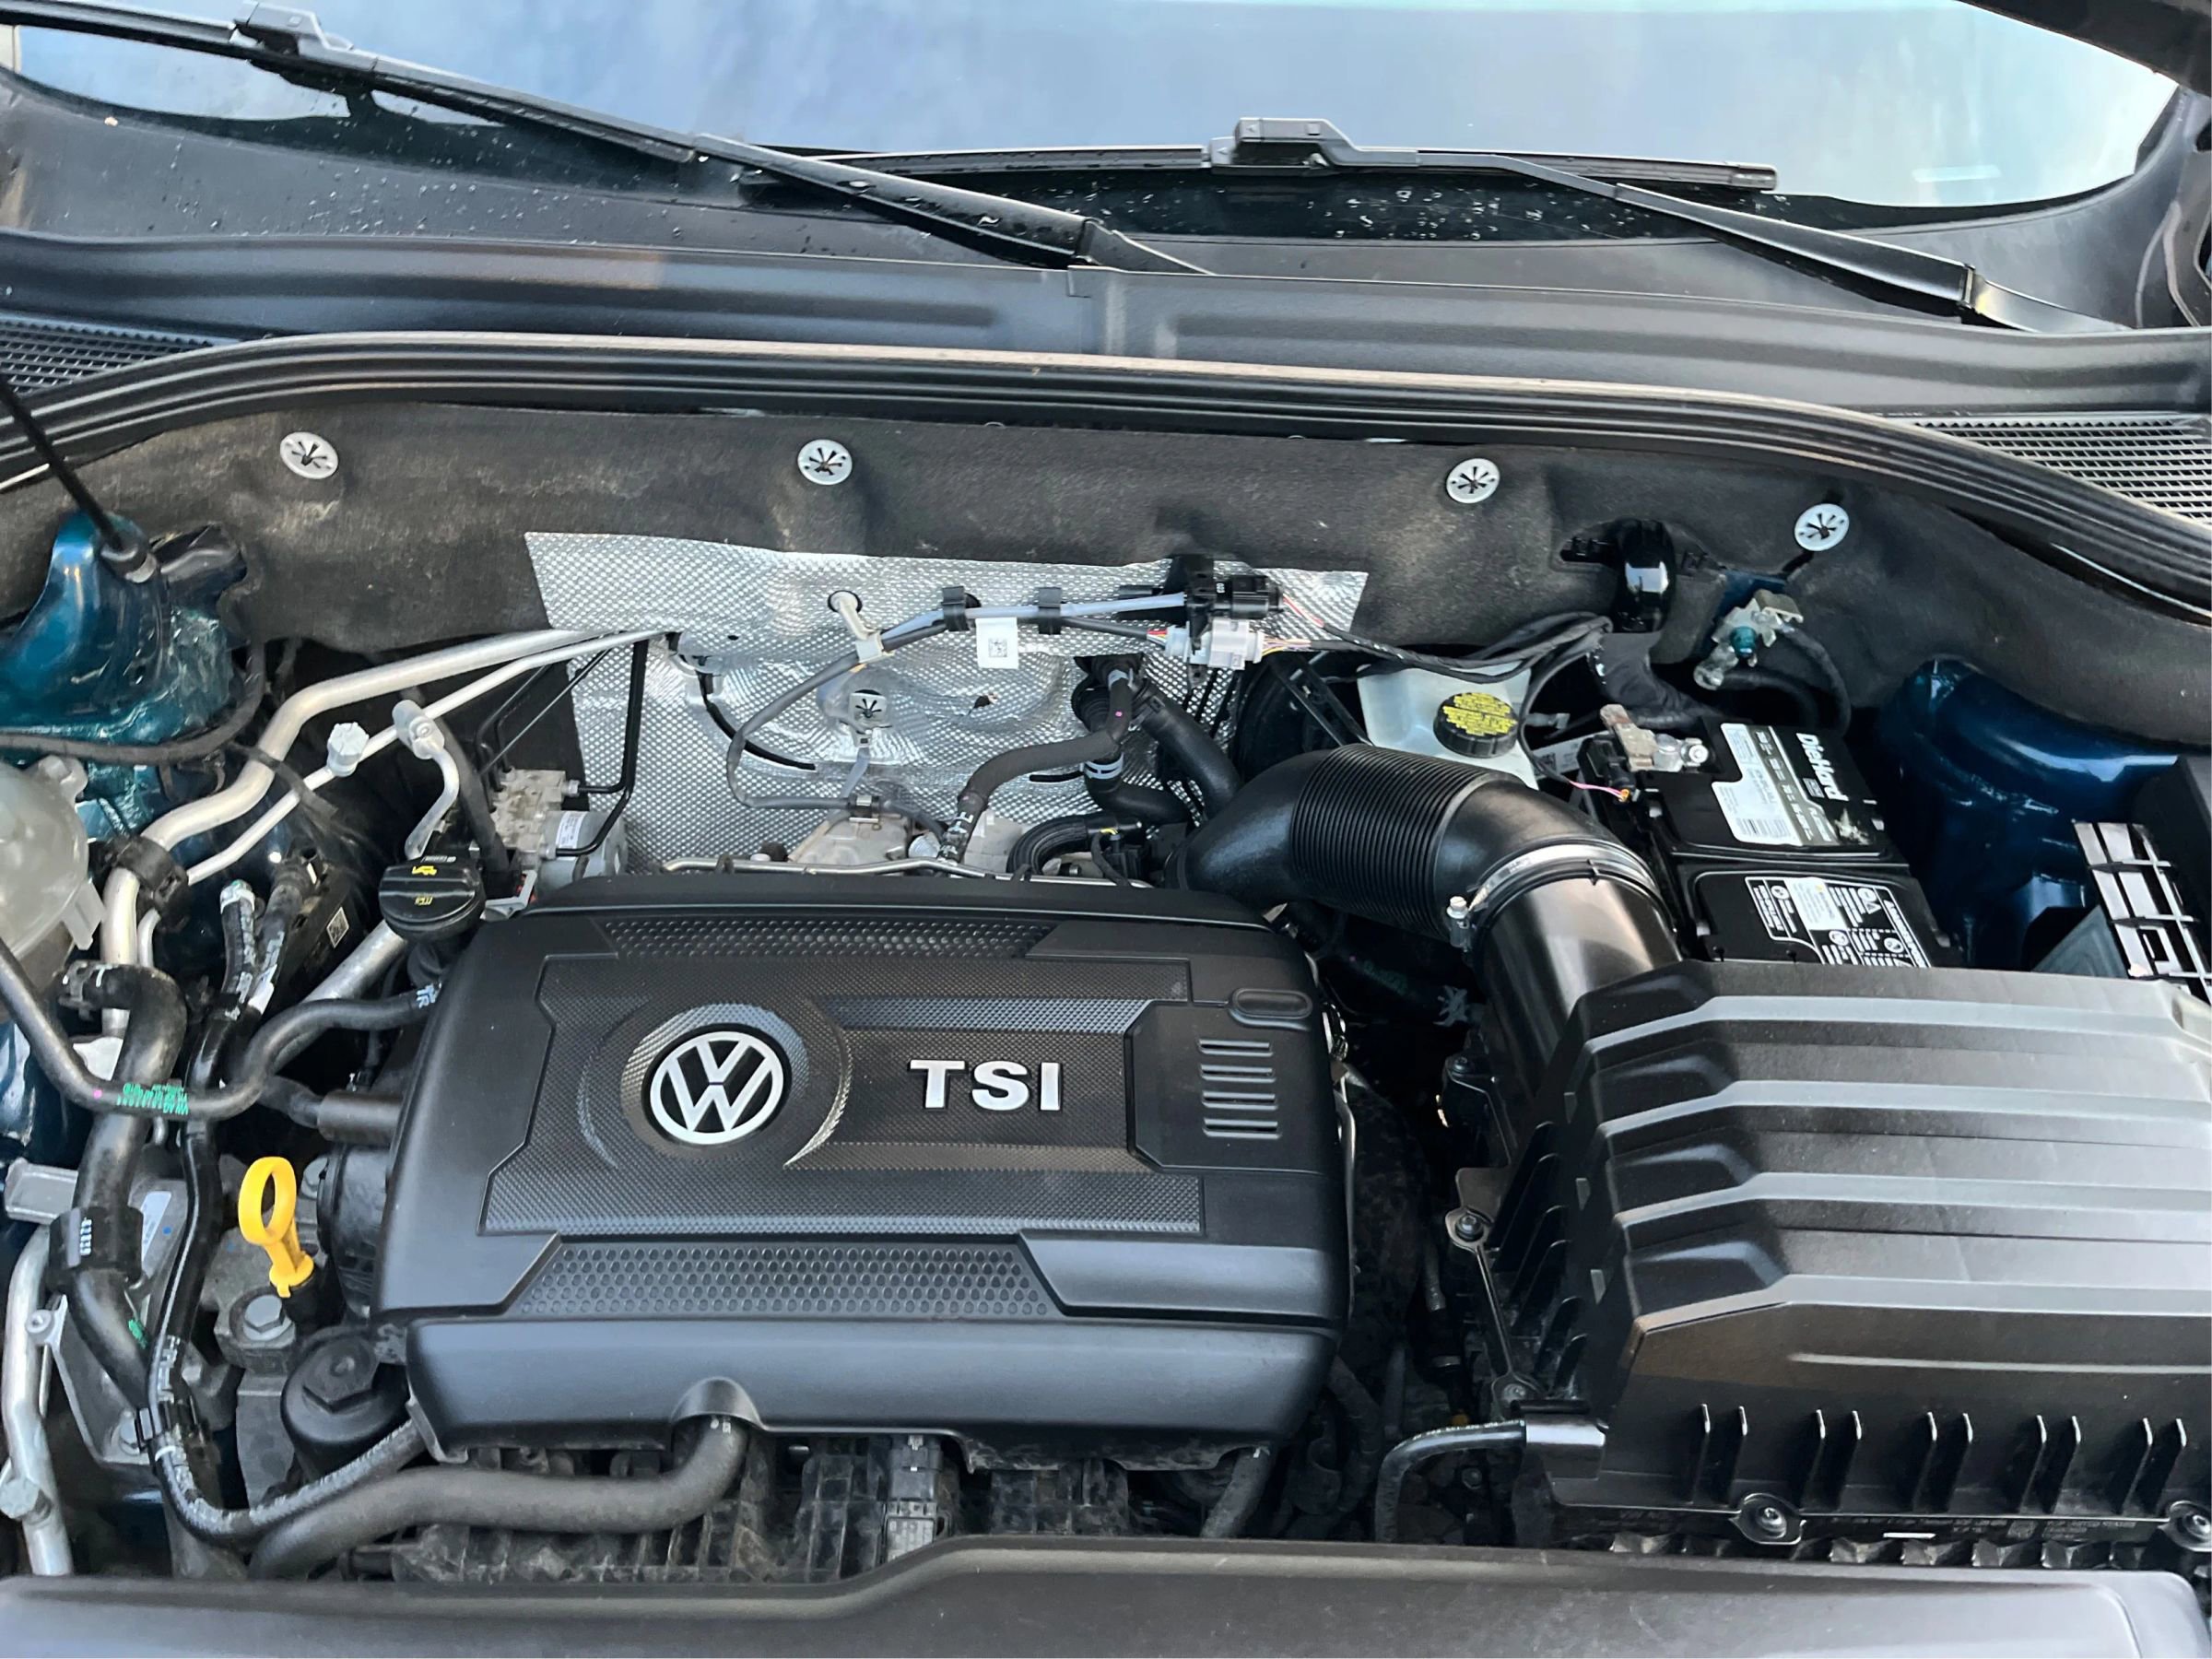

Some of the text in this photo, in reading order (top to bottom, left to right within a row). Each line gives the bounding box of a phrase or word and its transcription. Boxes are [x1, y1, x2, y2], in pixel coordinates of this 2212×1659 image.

[1795, 732, 1850, 802] DieHard
[650, 1030, 784, 1145] VW
[910, 1059, 1061, 1112] TSI
